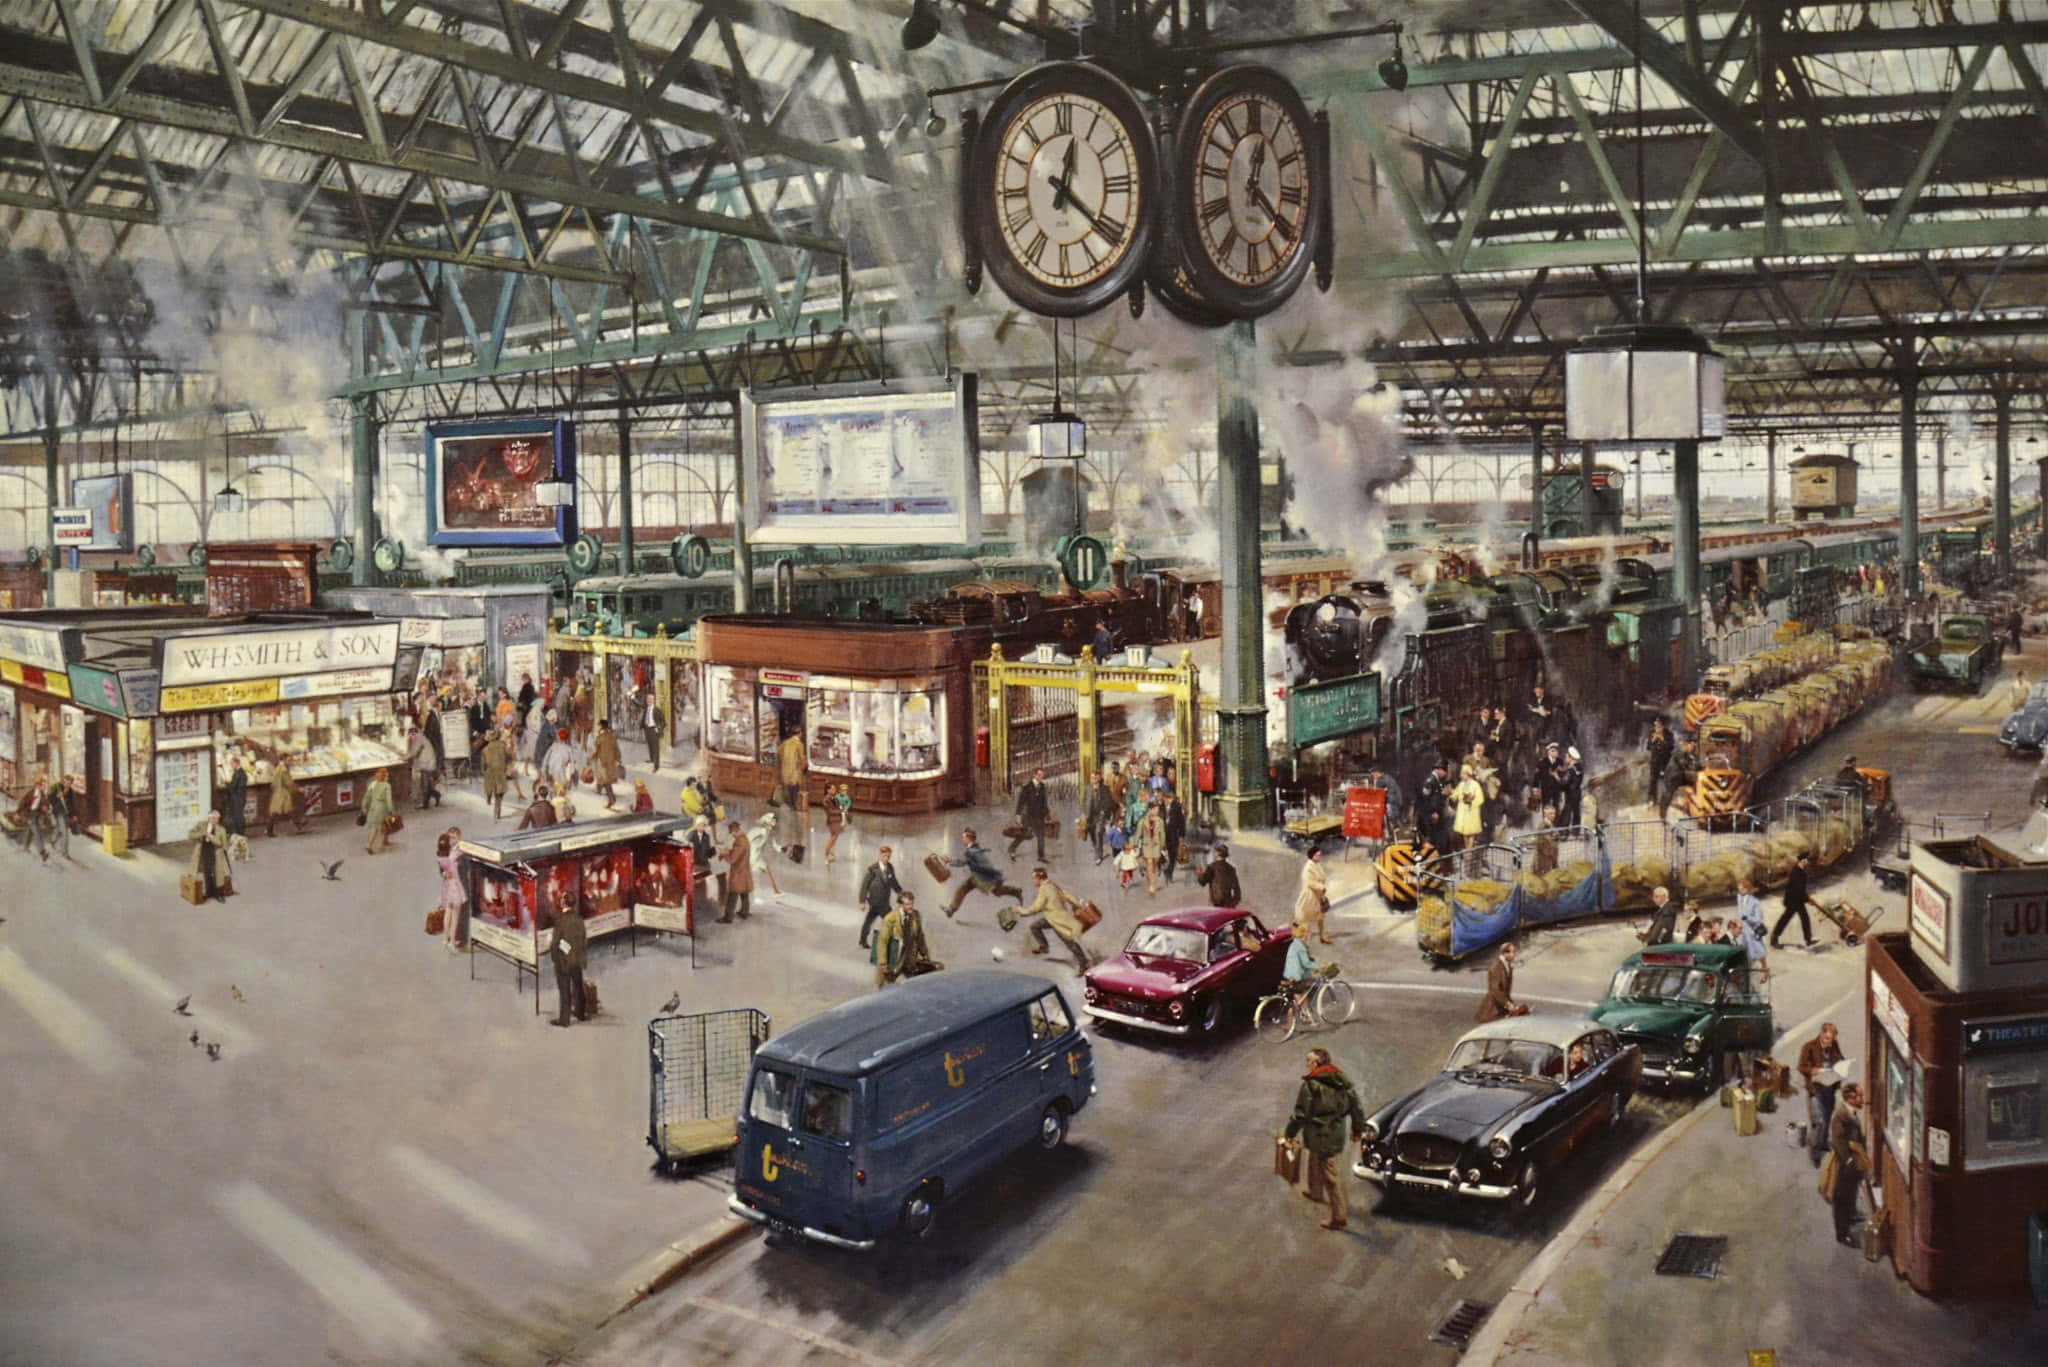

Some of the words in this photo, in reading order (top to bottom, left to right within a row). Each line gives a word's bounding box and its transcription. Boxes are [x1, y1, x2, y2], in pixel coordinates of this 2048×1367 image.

[574, 540, 591, 568] 9
[687, 543, 705, 571] 10
[1076, 547, 1094, 582] 11
[313, 641, 330, 659] &
[339, 633, 382, 657] SON
[218, 682, 275, 703] Telegraph
